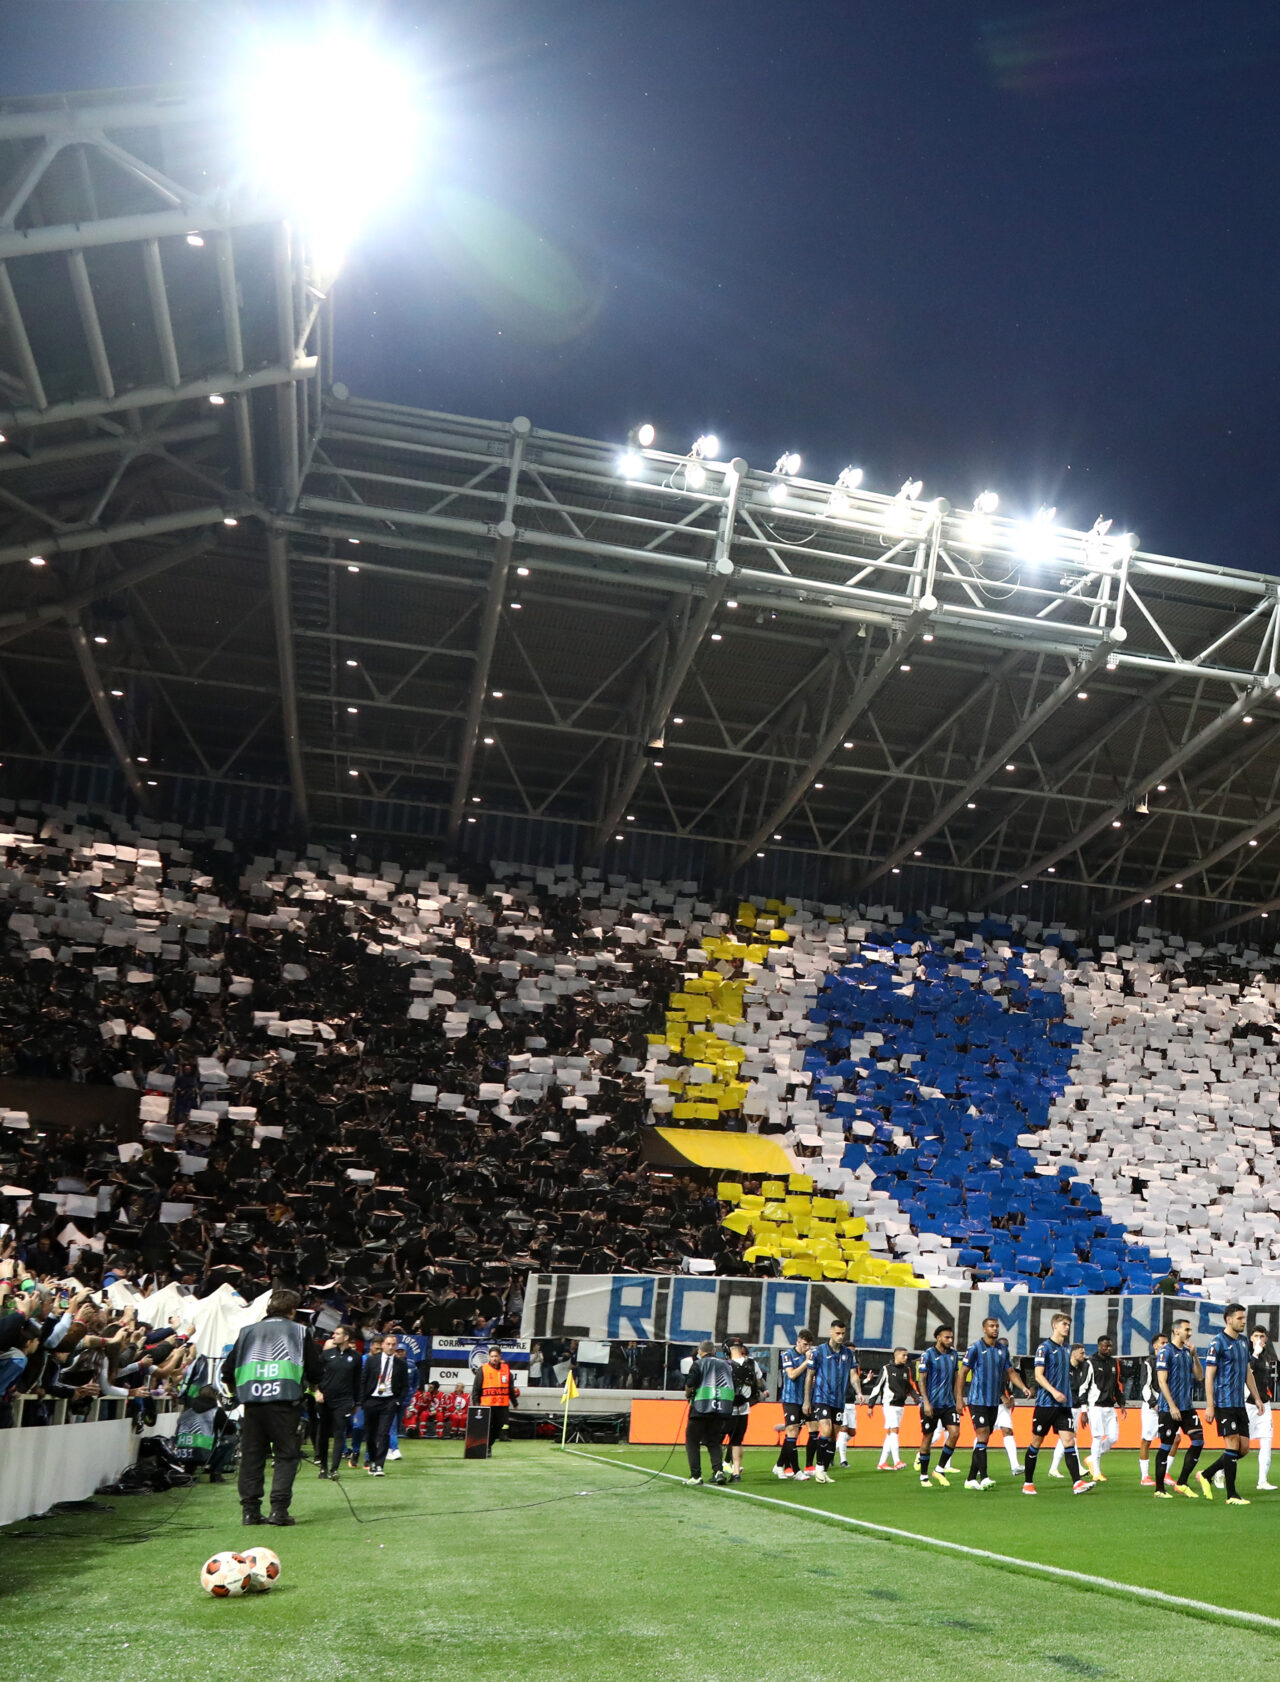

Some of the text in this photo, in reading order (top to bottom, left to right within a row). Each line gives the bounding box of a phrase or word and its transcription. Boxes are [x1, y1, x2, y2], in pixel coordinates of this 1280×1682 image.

[256, 1364, 279, 1378] HB
[440, 1371, 459, 1379] CON
[251, 1382, 280, 1397] 025
[178, 1435, 194, 1445] HB
